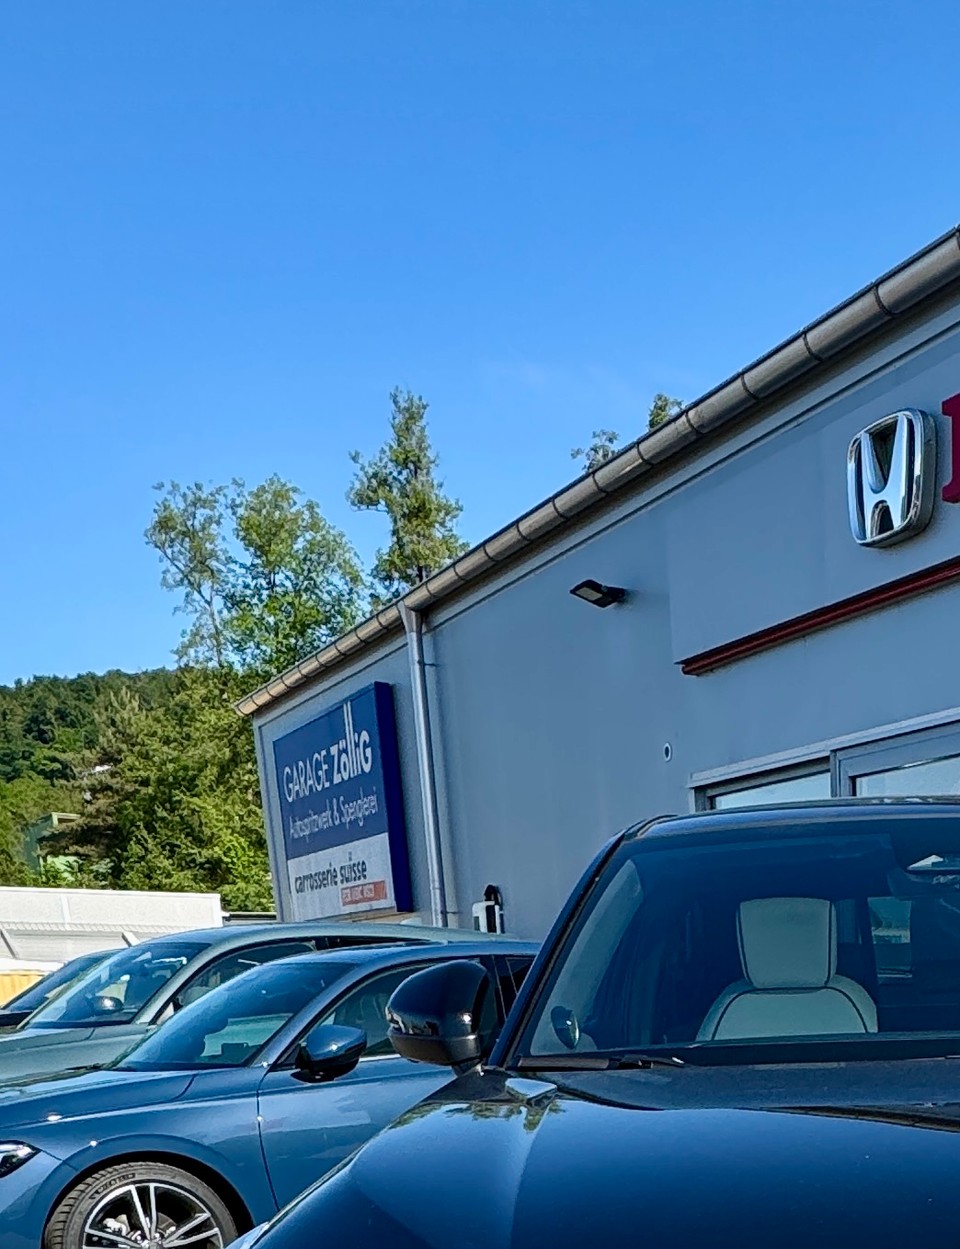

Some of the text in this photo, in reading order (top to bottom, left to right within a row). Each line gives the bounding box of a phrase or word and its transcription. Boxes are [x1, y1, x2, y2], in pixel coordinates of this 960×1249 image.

[283, 749, 330, 803] GARAGE
[340, 786, 379, 830] Spenglerei
[294, 862, 338, 894] carrosserie
[340, 851, 368, 885] suisse
